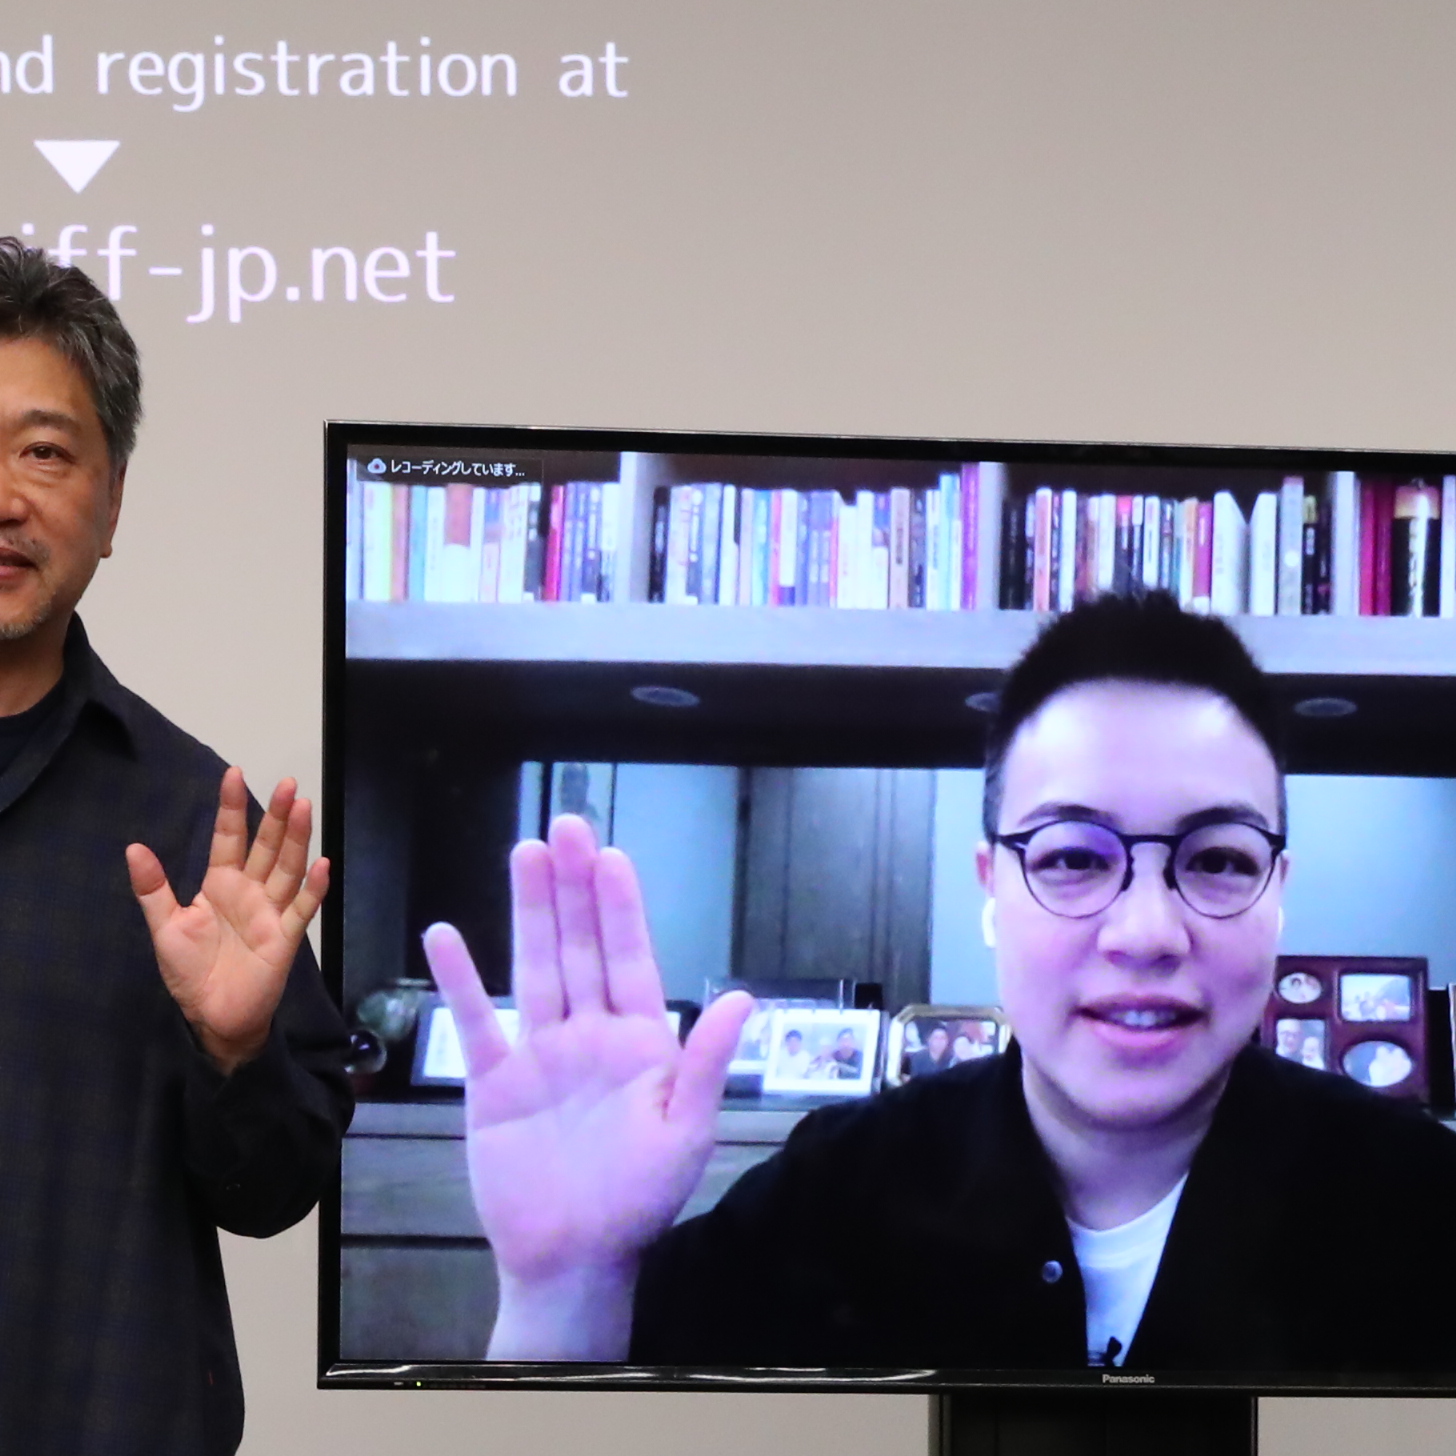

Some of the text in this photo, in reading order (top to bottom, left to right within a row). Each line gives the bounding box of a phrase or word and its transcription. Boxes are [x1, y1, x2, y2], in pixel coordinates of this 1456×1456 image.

[96, 34, 518, 113] registration
[557, 41, 630, 99] at
[1101, 1373, 1156, 1385] Panasonic
